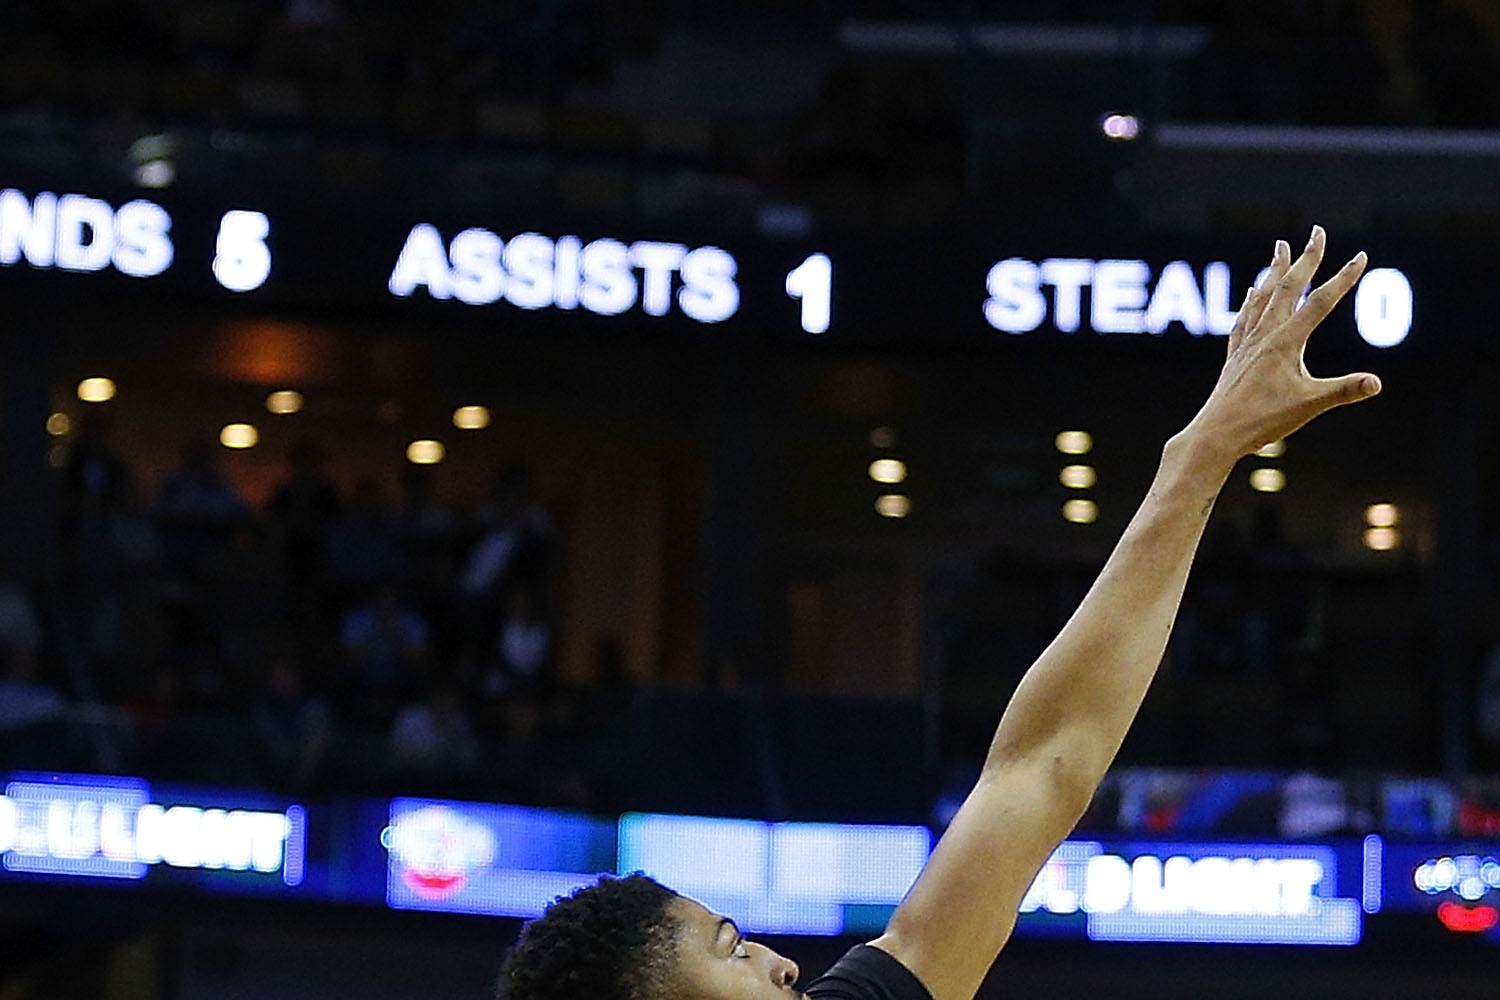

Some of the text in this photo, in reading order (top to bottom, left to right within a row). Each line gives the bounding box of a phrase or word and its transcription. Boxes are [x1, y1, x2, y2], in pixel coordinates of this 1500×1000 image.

[212, 210, 271, 292] 5
[388, 223, 833, 334] ASSISTS 1
[983, 257, 1413, 347] STEAL 0
